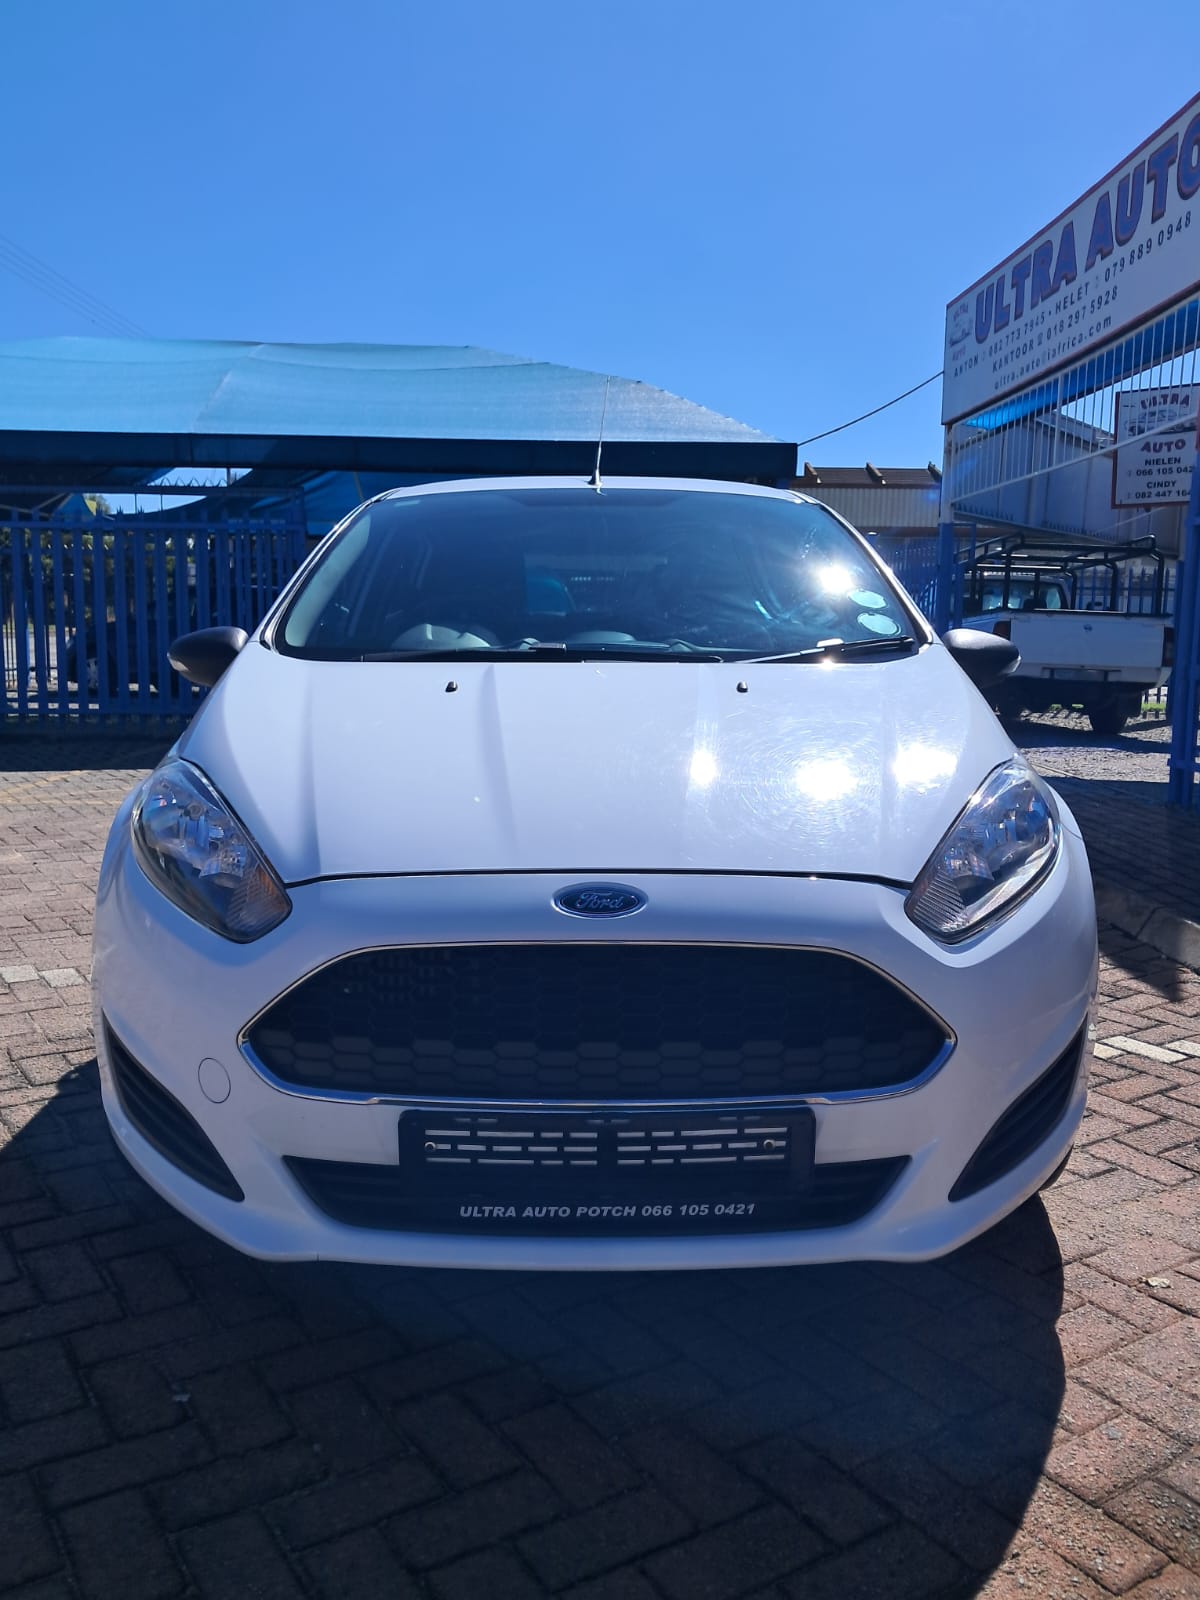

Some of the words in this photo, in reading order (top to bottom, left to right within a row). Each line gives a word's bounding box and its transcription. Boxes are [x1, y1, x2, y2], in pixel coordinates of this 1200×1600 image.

[975, 220, 1077, 344] ULTRA
[1085, 112, 1200, 272] AUTO
[1056, 281, 1090, 314] HELET
[1104, 257, 1125, 282] 079
[1129, 238, 1152, 265] 889
[1158, 210, 1191, 246] 0948
[992, 339, 1034, 373] KANTOOR
[1046, 320, 1064, 340] 018
[1068, 305, 1087, 328] 297
[1090, 285, 1118, 314] 5928
[1141, 439, 1186, 453] AUTO
[1144, 457, 1181, 466] NIELEN
[1157, 467, 1174, 475] 105
[1146, 480, 1176, 489] CINDY
[576, 892, 624, 909] Ford
[459, 1206, 516, 1217] ULTRA
[522, 1206, 571, 1217] AUTO
[576, 1206, 637, 1217] POTCH
[641, 1205, 673, 1217] 066
[679, 1204, 710, 1216] 105
[714, 1203, 755, 1215] 0421
